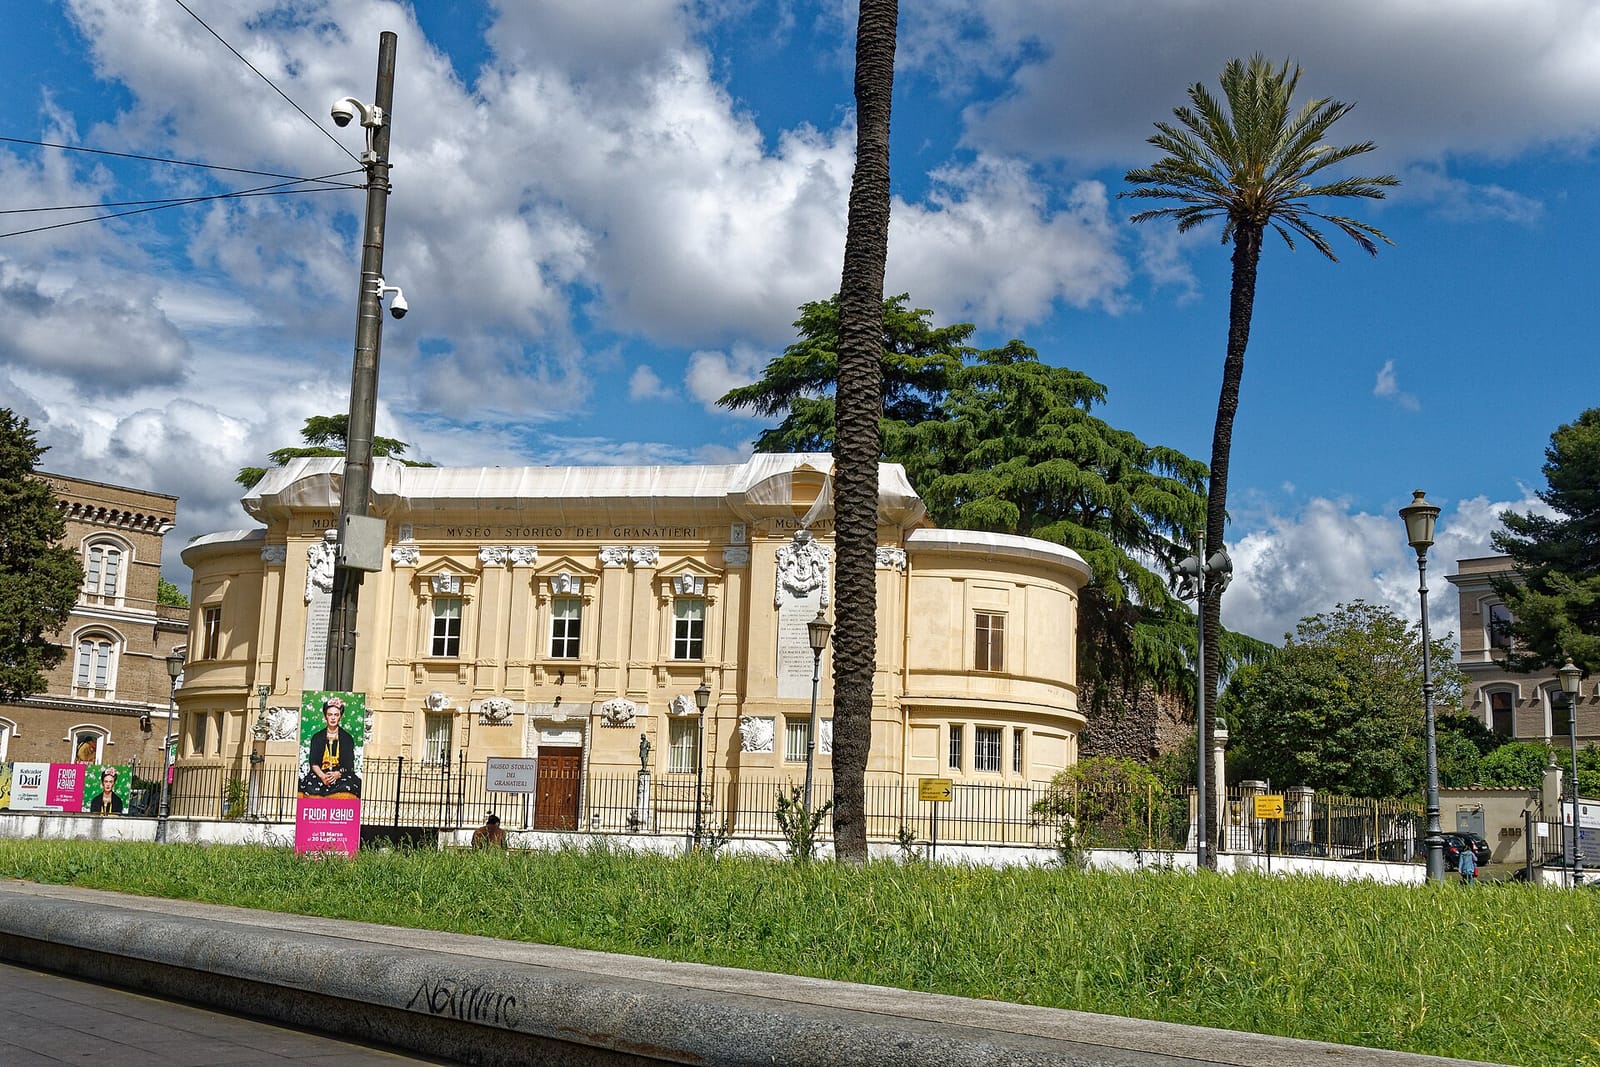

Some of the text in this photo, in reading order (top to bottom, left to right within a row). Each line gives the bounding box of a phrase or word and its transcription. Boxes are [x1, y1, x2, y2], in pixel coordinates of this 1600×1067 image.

[775, 519, 835, 528] MCMXIV
[505, 528, 562, 537] STORICO
[576, 528, 600, 537] DEI
[613, 528, 697, 537] GRANATIERI
[19, 774, 42, 786] Dalí
[303, 808, 328, 821] FRIDA
